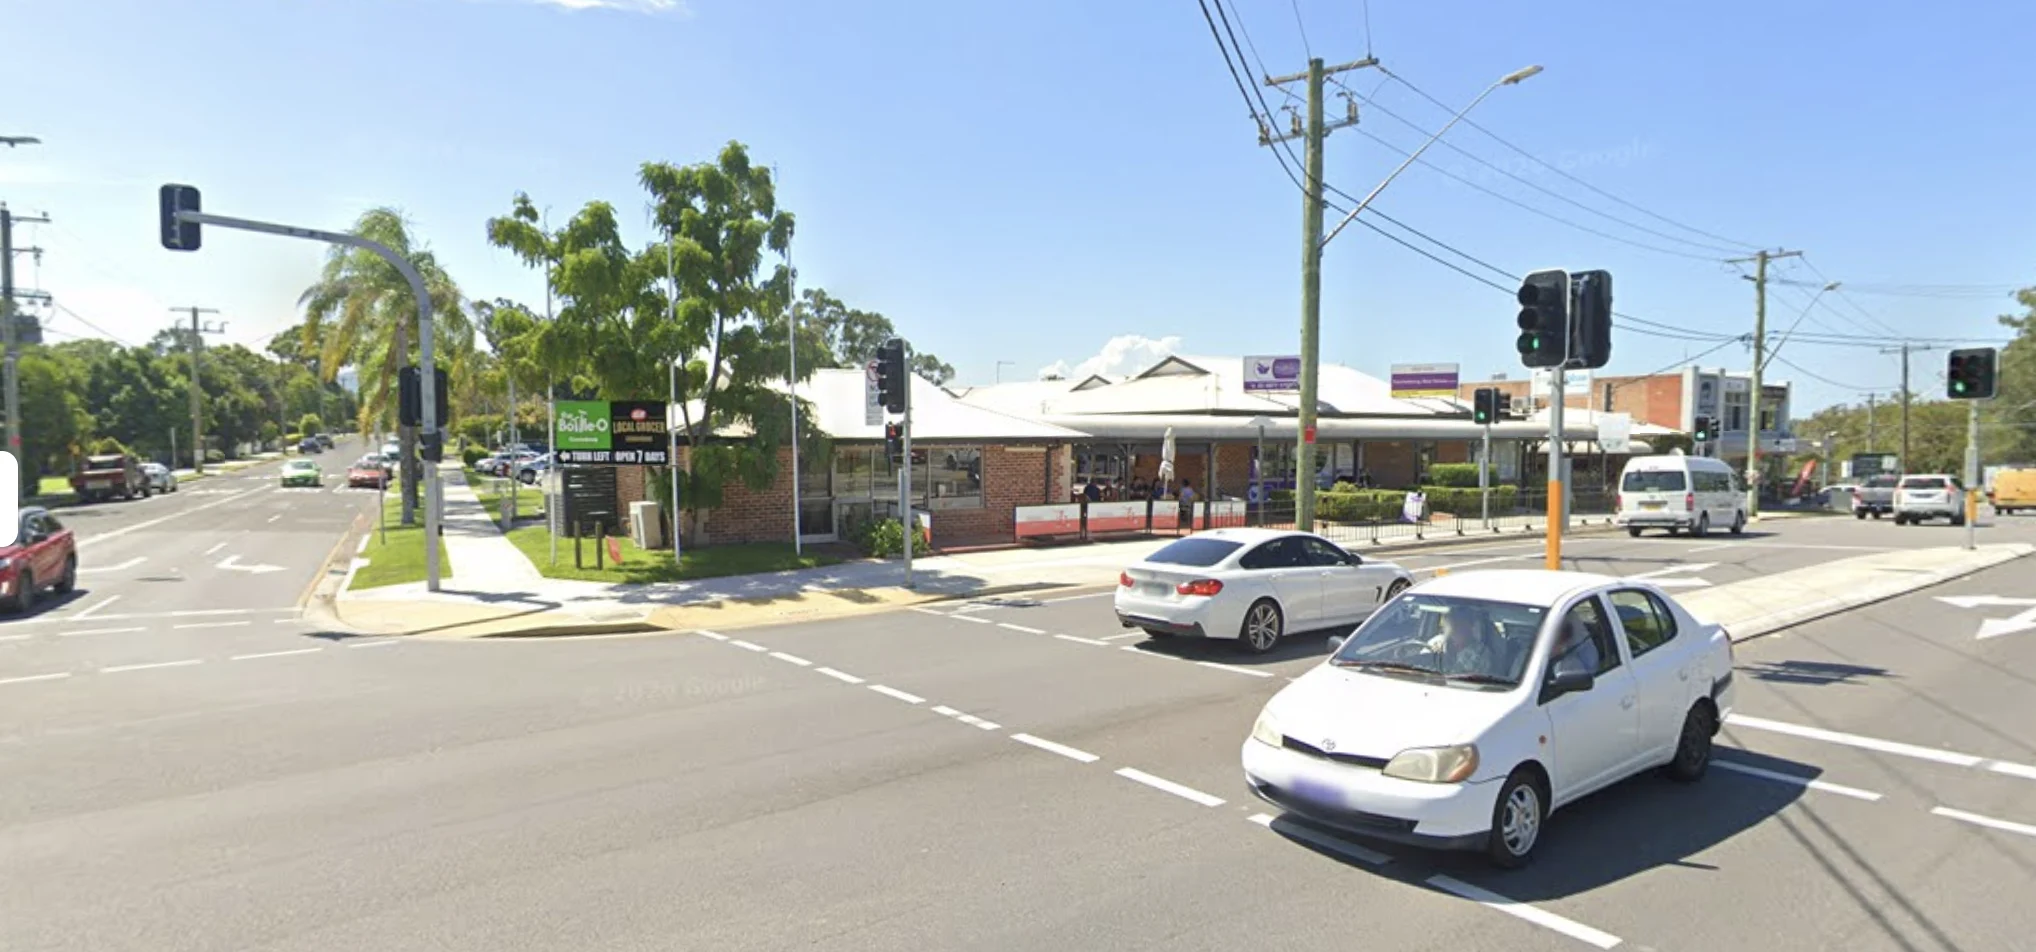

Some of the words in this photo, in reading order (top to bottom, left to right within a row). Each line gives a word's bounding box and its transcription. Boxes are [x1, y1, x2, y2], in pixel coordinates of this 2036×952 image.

[613, 421, 634, 433] LOCAL
[635, 421, 666, 433] GROCER
[572, 451, 593, 461] TURN
[593, 451, 610, 461] LEFT
[615, 451, 636, 462] OPEN
[636, 450, 643, 464] 7
[644, 451, 666, 462] DAYS
